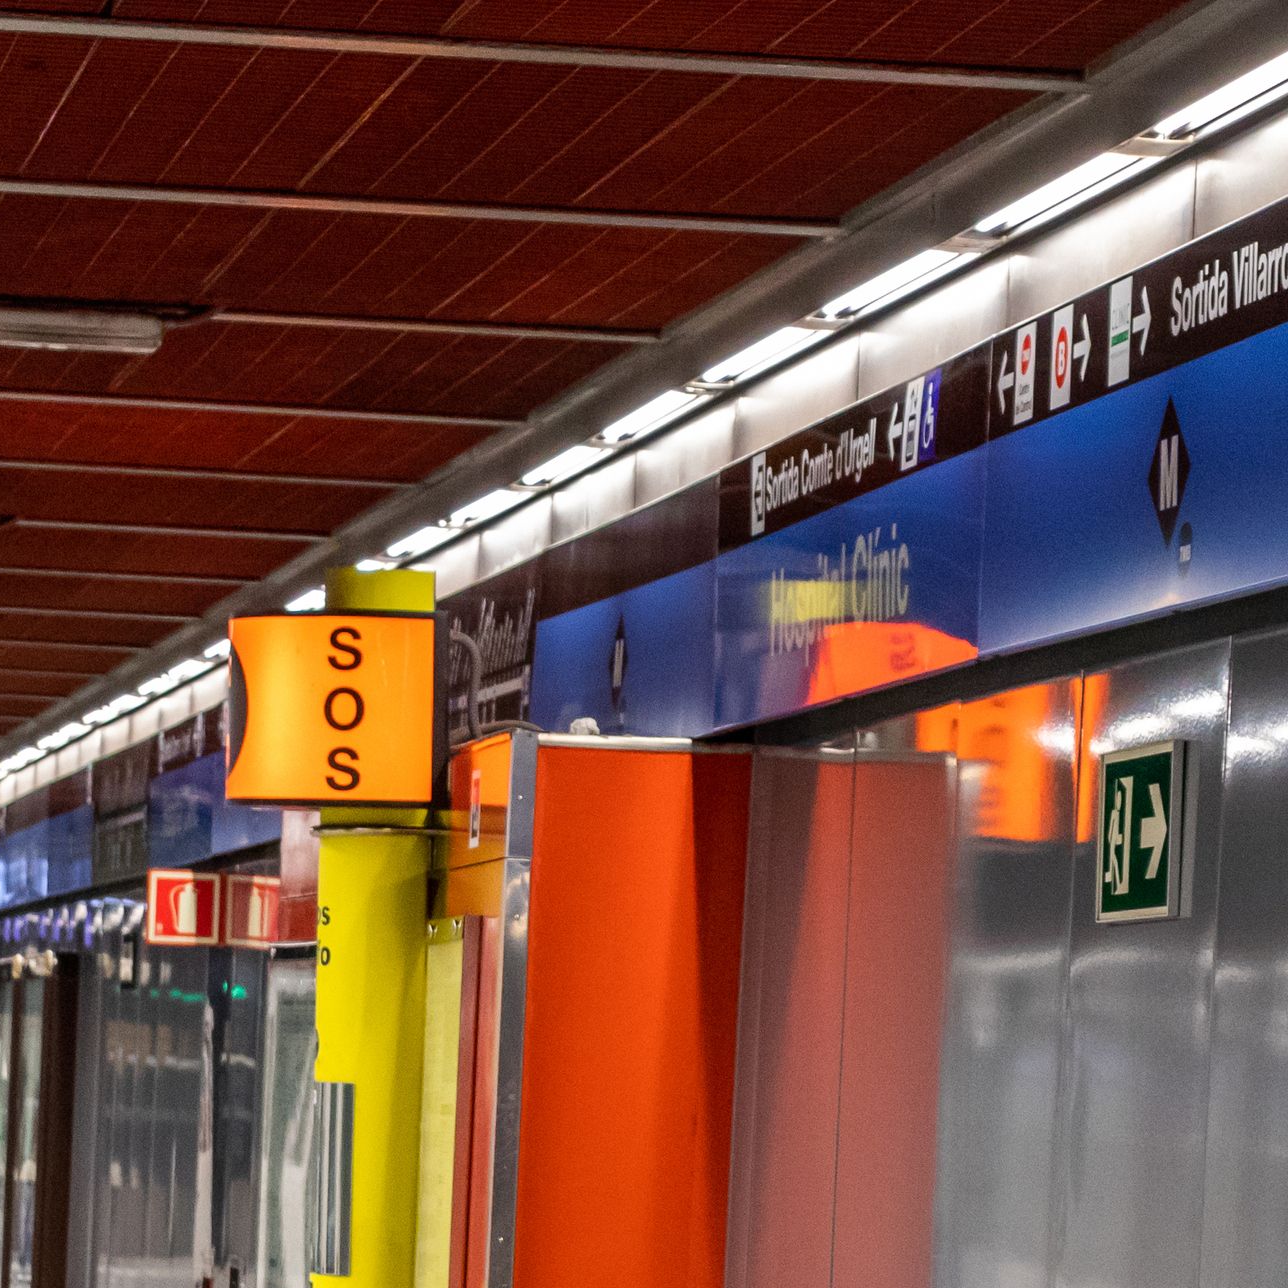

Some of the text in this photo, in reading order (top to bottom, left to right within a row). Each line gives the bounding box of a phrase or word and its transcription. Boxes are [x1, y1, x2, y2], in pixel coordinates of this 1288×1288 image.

[1170, 259, 1228, 337] Sortida
[765, 416, 877, 512] Sortida Comte d'Urgell
[851, 522, 910, 630] Clínic
[324, 626, 365, 792] SOS
